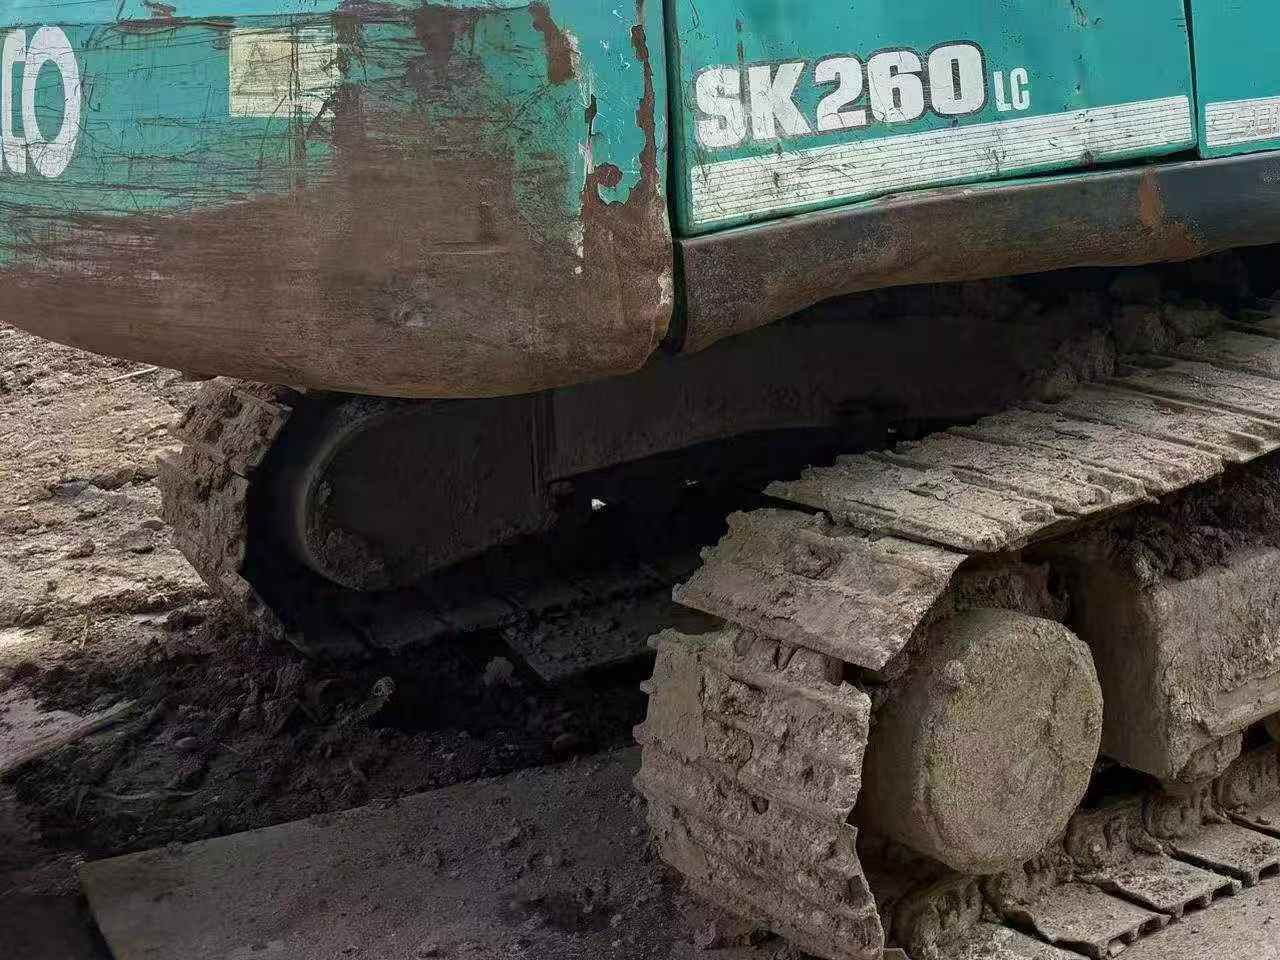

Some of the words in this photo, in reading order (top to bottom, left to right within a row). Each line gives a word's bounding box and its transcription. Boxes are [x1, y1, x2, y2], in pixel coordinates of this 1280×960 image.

[0, 26, 81, 178] CO
[693, 42, 988, 149] SK260
[992, 67, 1031, 112] LC
